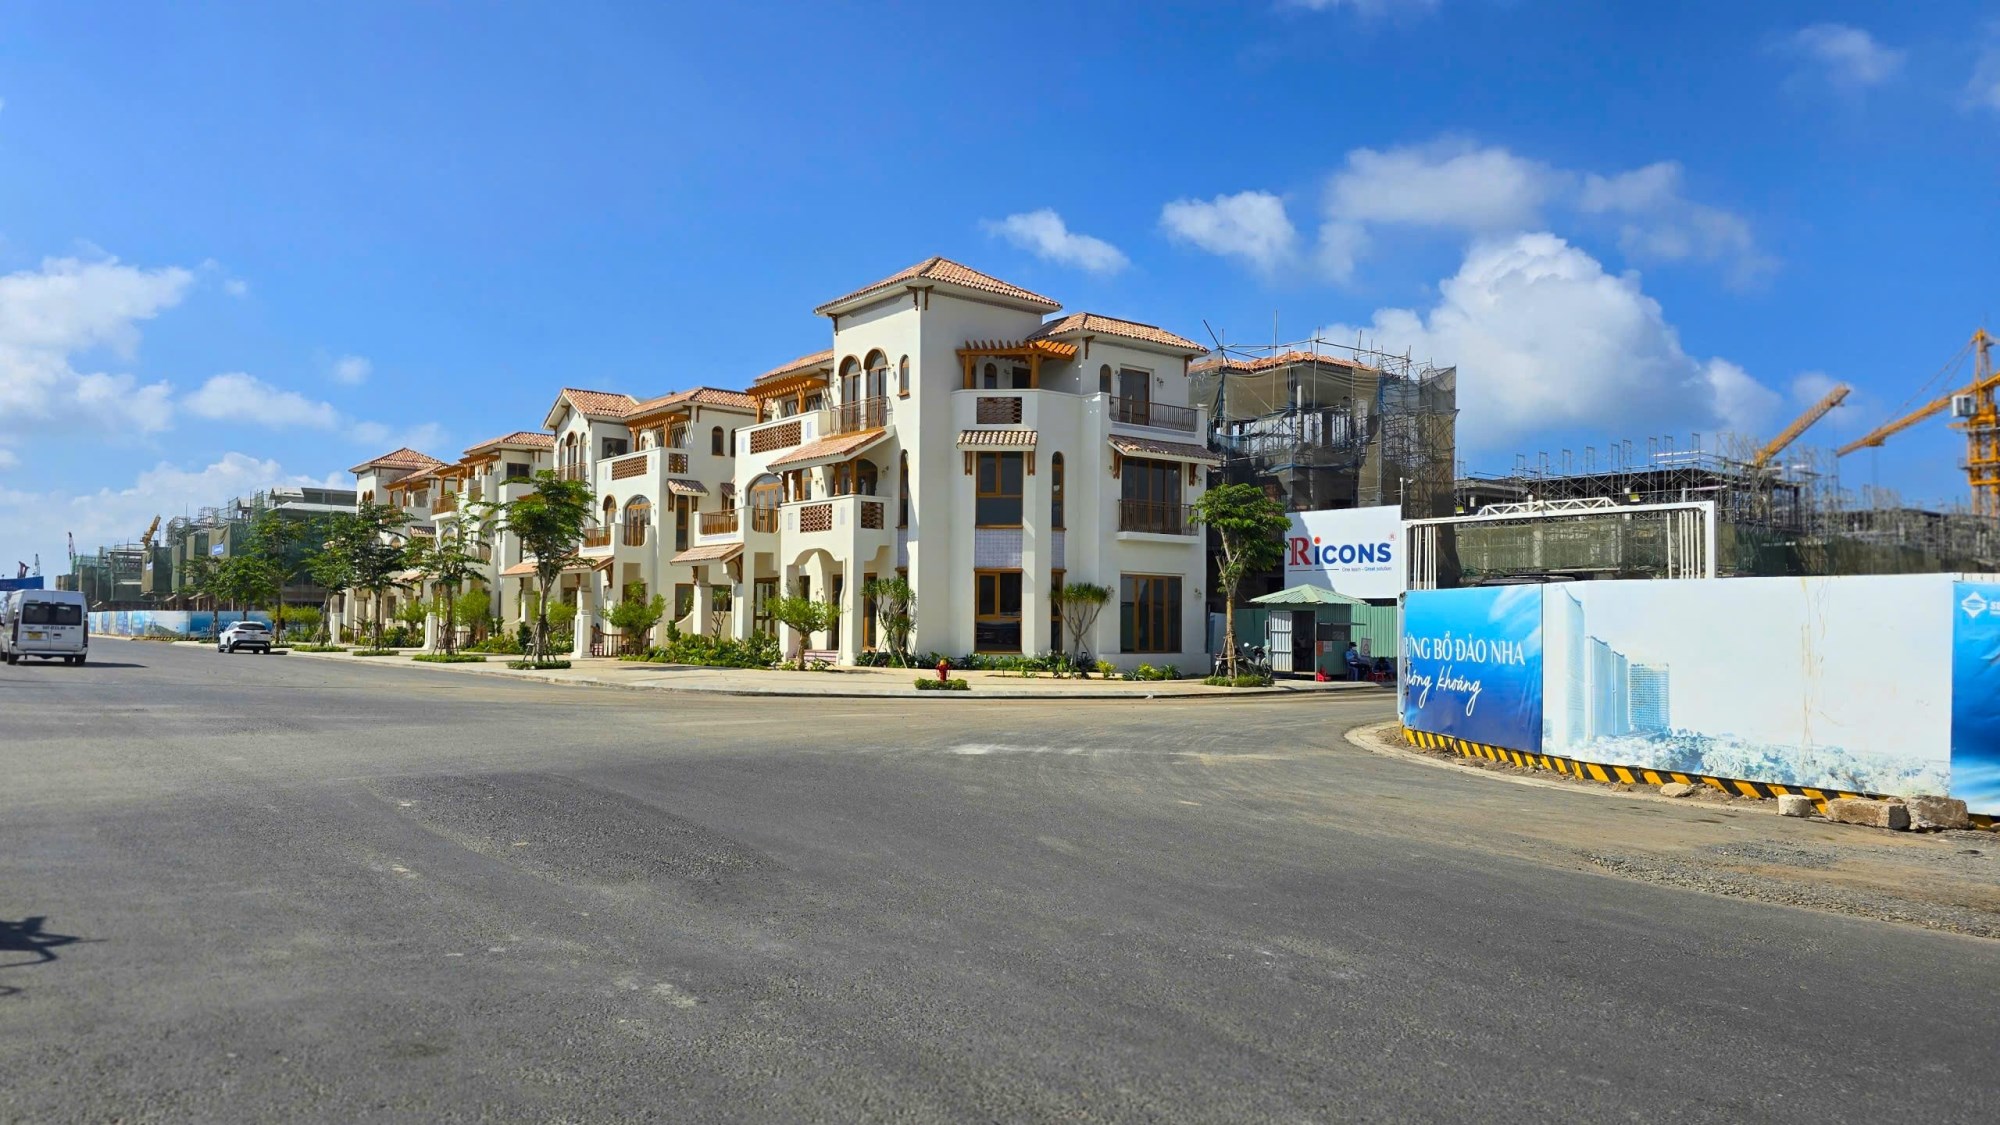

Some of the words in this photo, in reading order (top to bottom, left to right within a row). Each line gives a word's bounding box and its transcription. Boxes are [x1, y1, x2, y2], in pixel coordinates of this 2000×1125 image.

[1455, 633, 1487, 663] ĐÀO
[1490, 639, 1526, 666] NHA
[1405, 665, 1433, 709] hóng
[1436, 664, 1483, 717] khoáng
